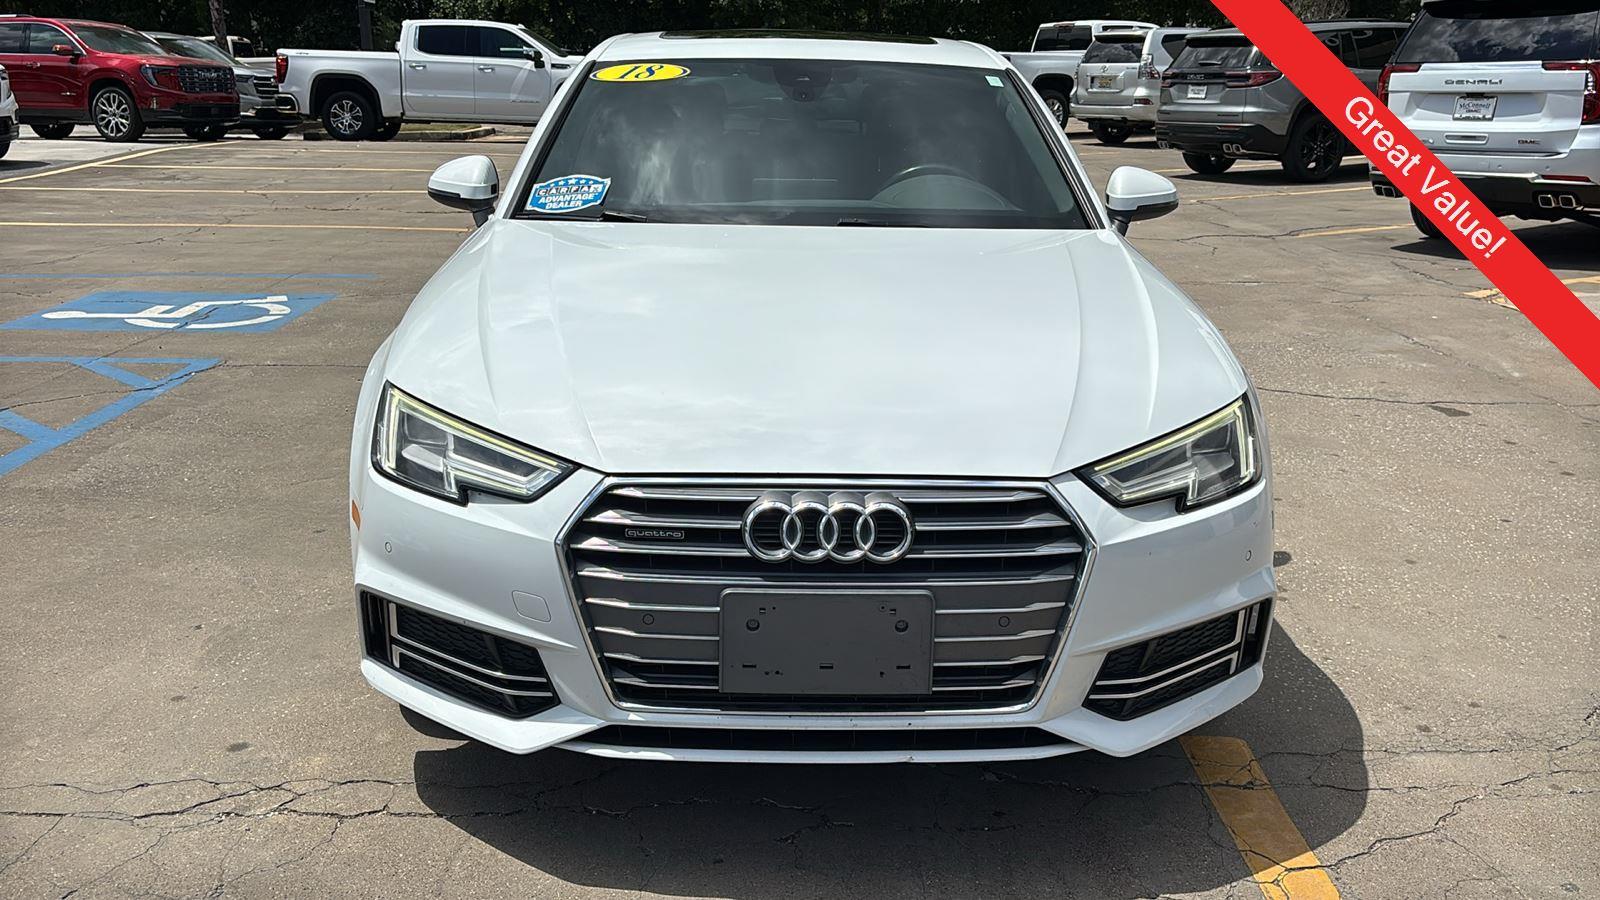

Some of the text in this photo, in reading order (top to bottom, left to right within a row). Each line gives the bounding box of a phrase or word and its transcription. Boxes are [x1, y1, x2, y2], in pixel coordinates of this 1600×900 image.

[618, 64, 664, 79] 18
[1459, 101, 1491, 109] McConnell
[537, 184, 603, 196] CARFAX
[538, 193, 594, 204] ADVANTAGE
[545, 201, 583, 209] DEALER
[627, 530, 682, 538] quattro
